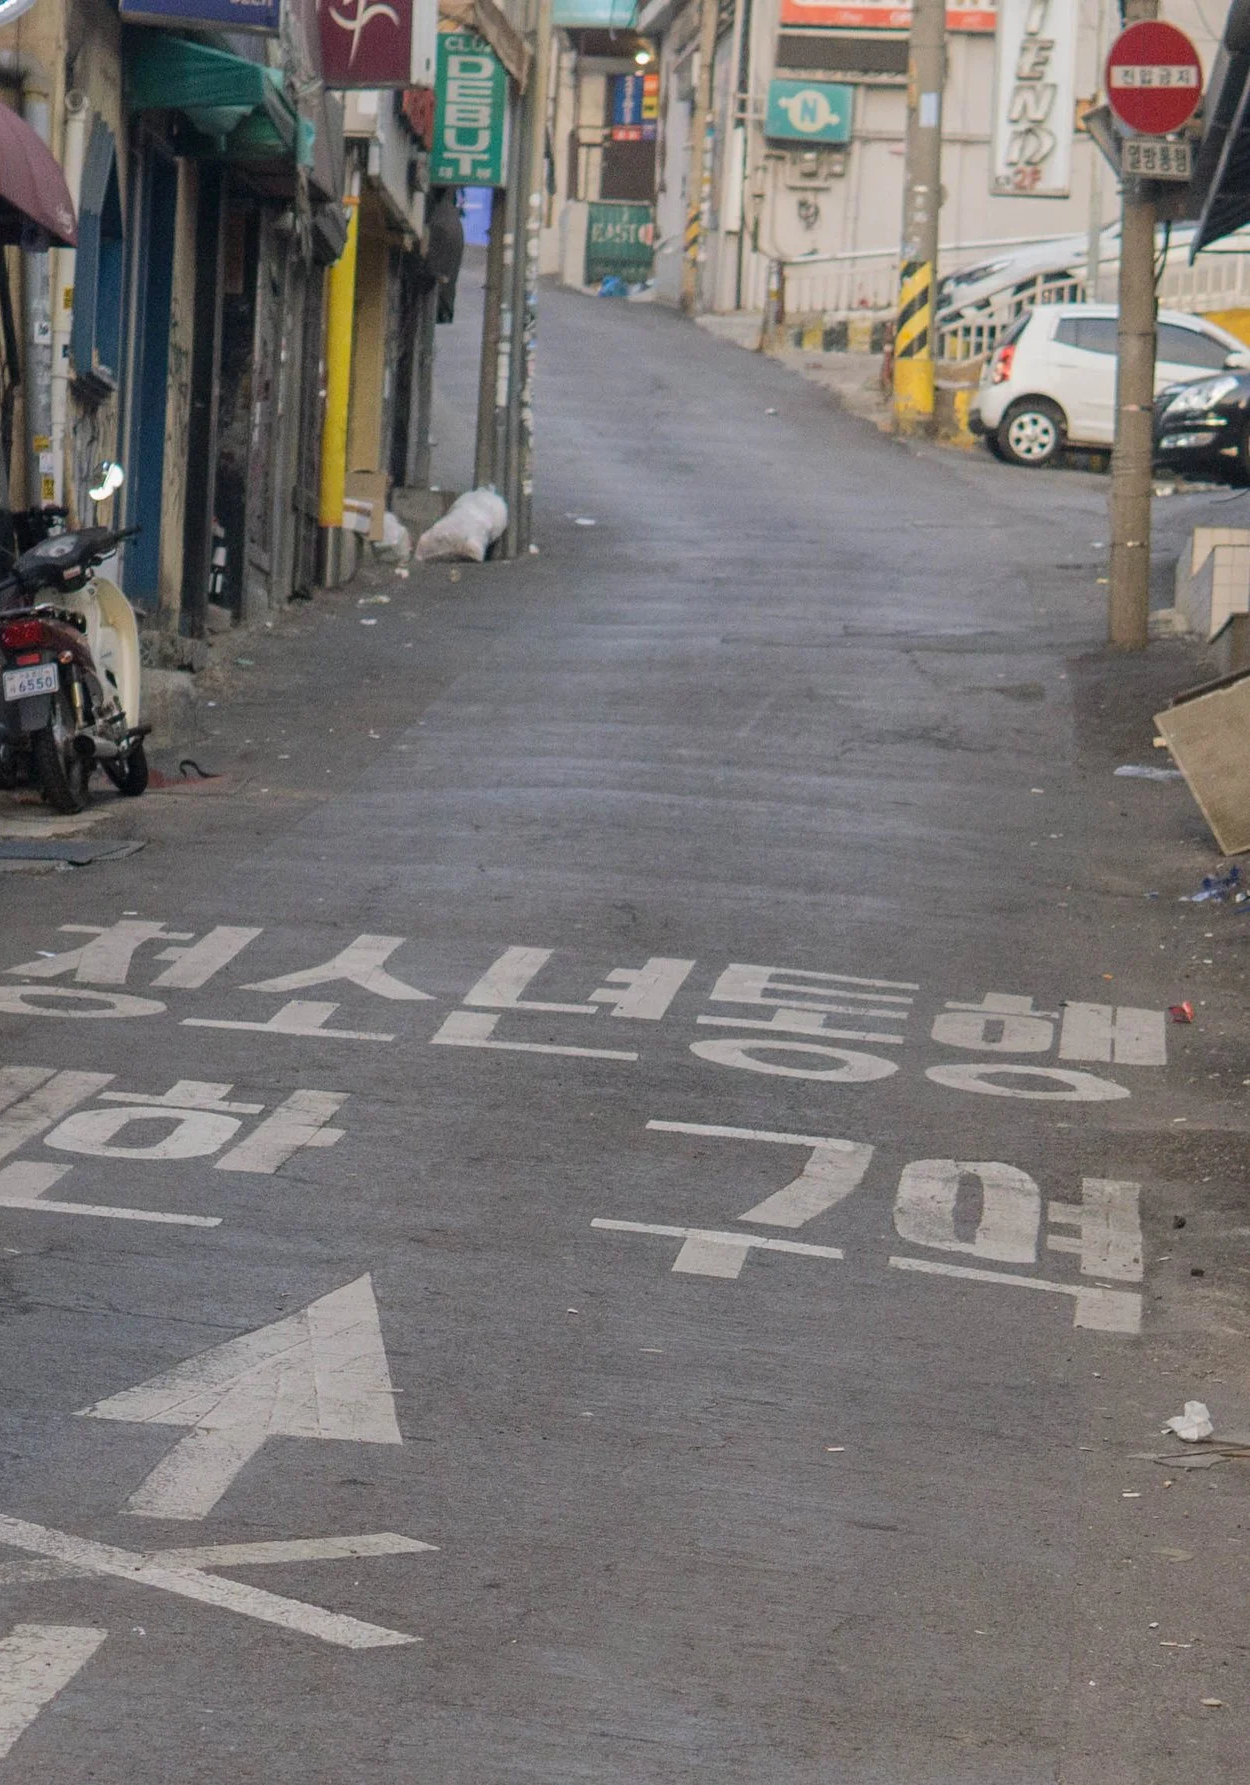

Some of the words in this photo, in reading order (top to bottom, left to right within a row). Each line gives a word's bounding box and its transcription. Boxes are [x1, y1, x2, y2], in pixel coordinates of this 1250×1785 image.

[1121, 68, 1190, 86] 진입금지
[442, 54, 495, 176] DEBUT
[1128, 144, 1187, 172] 일방통행
[18, 676, 53, 693] 6550
